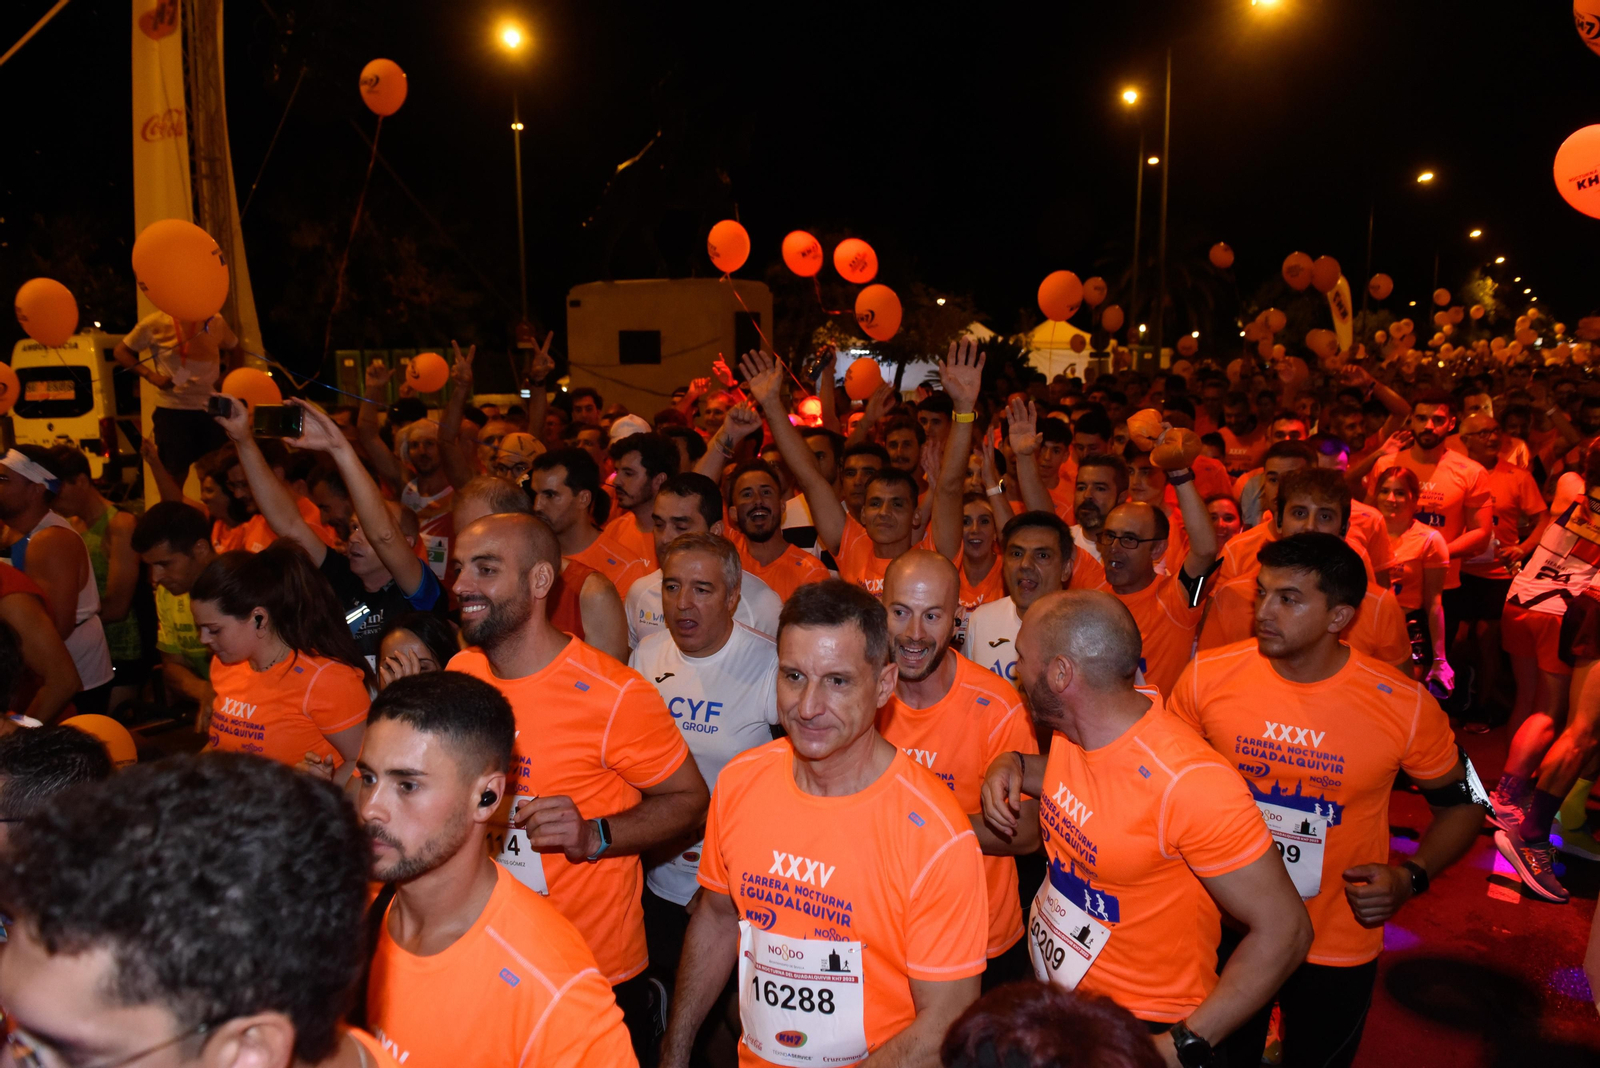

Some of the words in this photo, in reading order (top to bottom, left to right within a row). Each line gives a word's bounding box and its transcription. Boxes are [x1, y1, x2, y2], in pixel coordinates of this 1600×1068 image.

[221, 697, 258, 720] XXXV
[661, 696, 723, 723] CYF
[230, 718, 266, 731] NOCTURNA
[682, 721, 719, 735] GROUP
[1262, 720, 1326, 749] XXXV
[1236, 735, 1283, 753] CARRERA
[1286, 744, 1346, 764] NOCTURNA
[1241, 746, 1344, 775] GUADALQUIVIR
[1051, 781, 1094, 828] XXXV
[1061, 816, 1099, 855] NOCTURNA
[768, 849, 836, 889] XXXV
[742, 871, 790, 893] CARRERA
[794, 884, 853, 913] NOCTURNA
[746, 886, 851, 928] GUADALQUIVIR
[752, 975, 836, 1015] 16288
[779, 1033, 803, 1046] KH7
[822, 1053, 861, 1063] Cruzcampo
